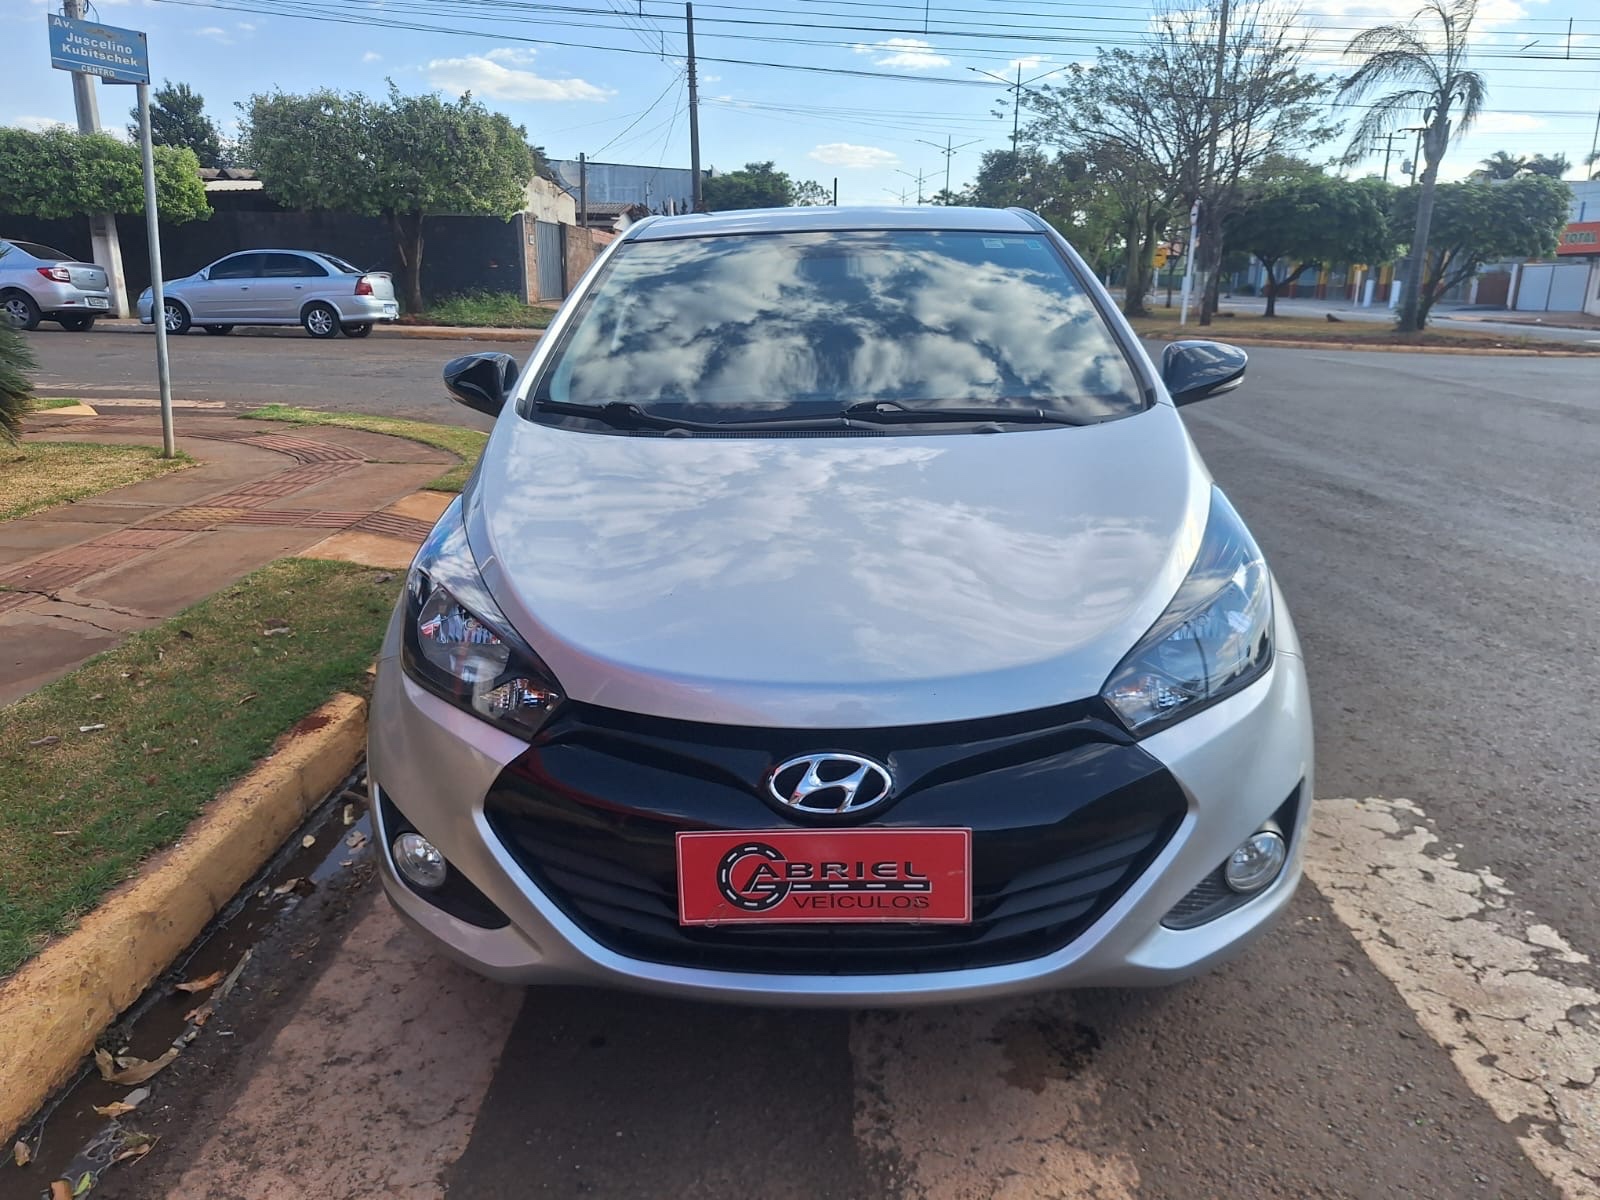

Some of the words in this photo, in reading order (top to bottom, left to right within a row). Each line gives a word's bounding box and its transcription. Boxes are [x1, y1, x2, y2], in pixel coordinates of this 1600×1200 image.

[53, 17, 73, 29] Av.
[66, 32, 133, 55] Juscelino
[62, 43, 138, 67] Kubitschek
[81, 65, 115, 77] CENTRO
[792, 893, 930, 909] VEÍCULOS
